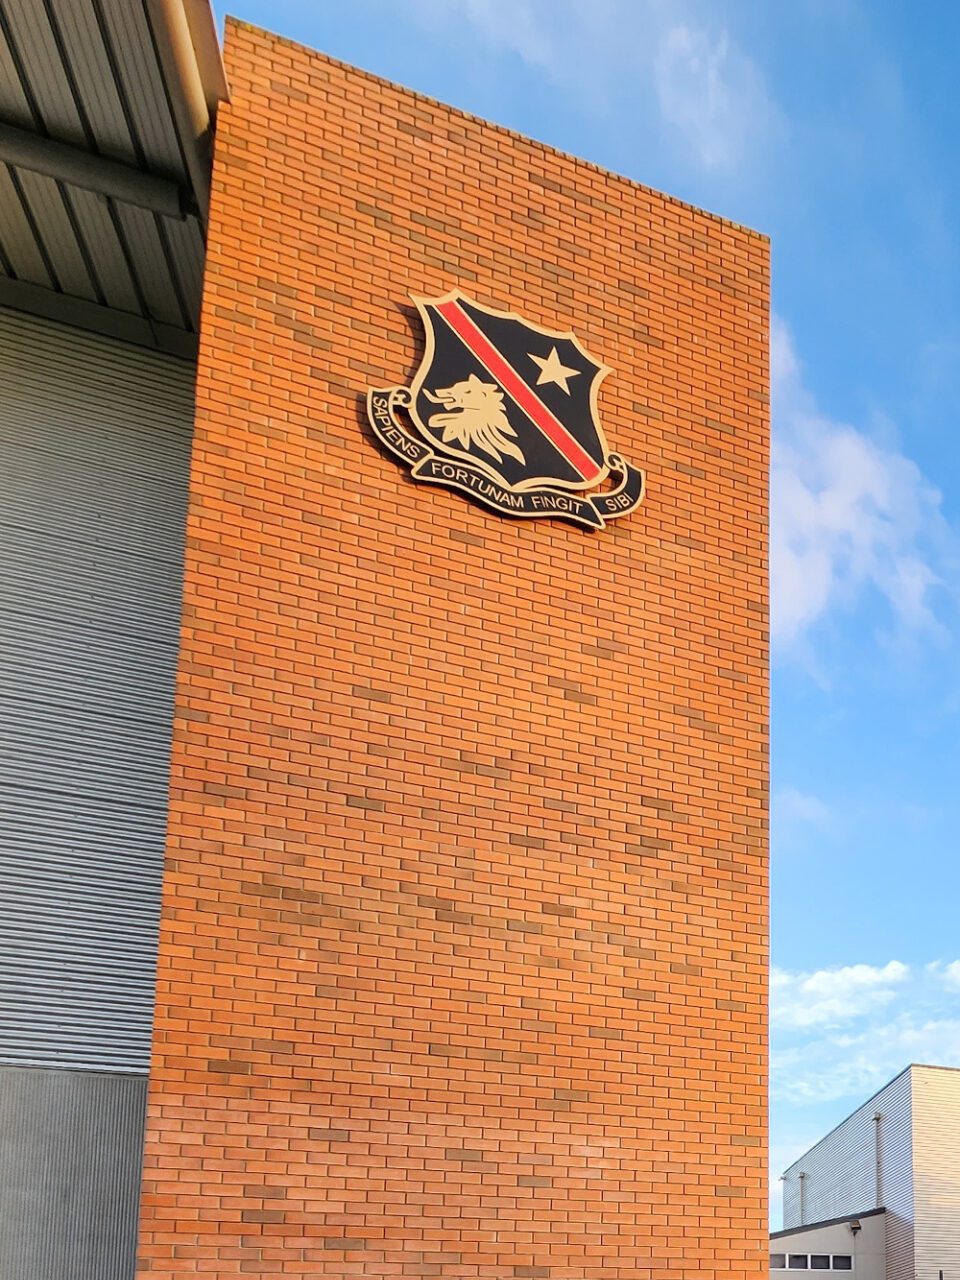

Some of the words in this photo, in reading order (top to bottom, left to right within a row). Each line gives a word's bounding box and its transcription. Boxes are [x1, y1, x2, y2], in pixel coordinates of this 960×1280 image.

[373, 397, 420, 458] SAPIENS
[431, 462, 524, 509] FORTUNAM
[532, 493, 584, 514] FINGIT
[605, 493, 634, 512] SIBI
